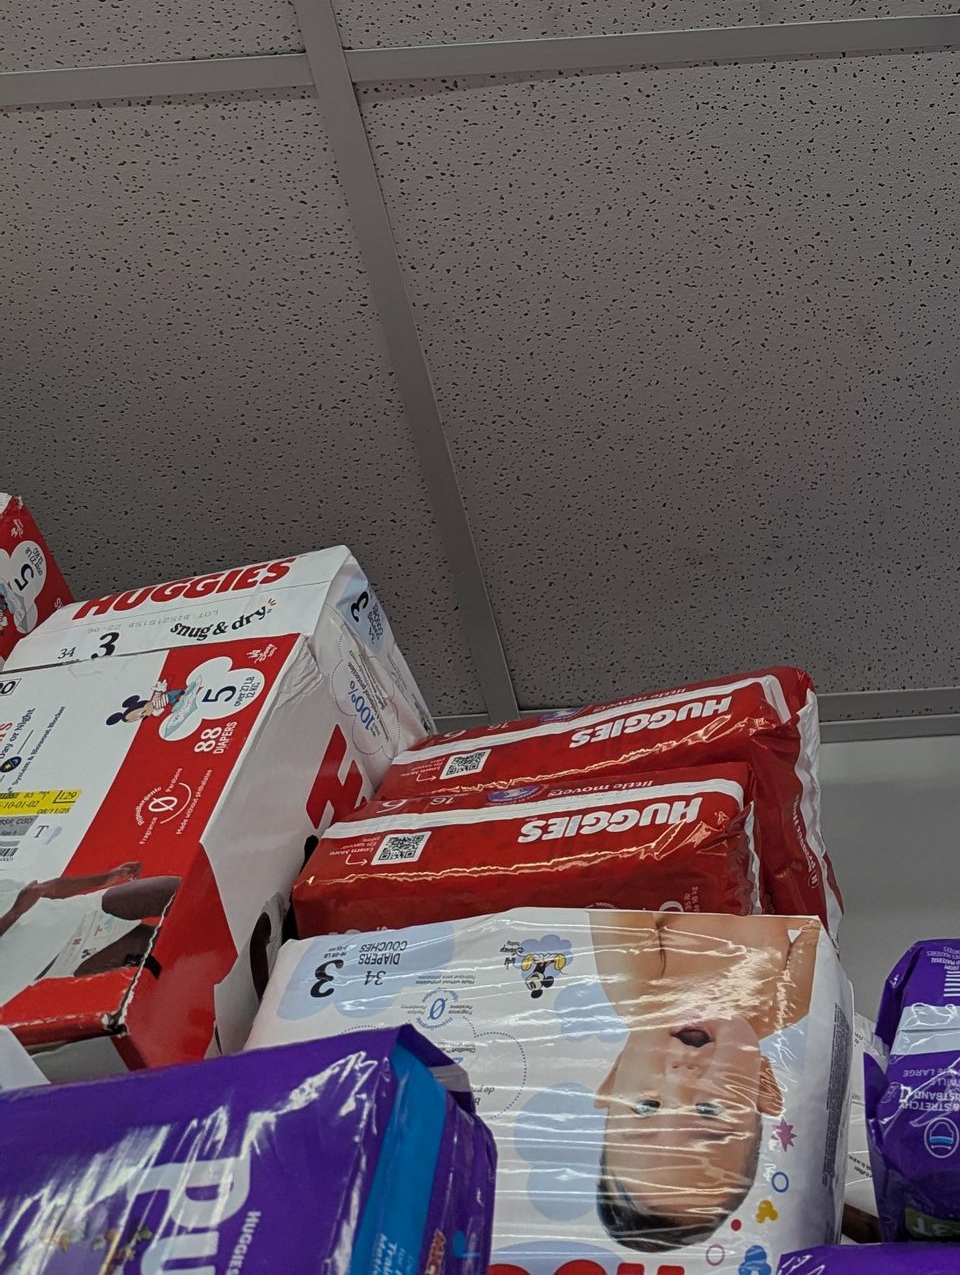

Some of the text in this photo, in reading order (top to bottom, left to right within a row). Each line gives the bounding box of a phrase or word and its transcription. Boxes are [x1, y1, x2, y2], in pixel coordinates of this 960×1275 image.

[14, 563, 34, 591] 5
[72, 556, 298, 621] HUGGIES
[350, 591, 369, 623] 3
[58, 604, 269, 660] 34 3 snug & dry
[202, 685, 237, 703] 5
[347, 679, 376, 731] 100%
[569, 696, 732, 749] HUGGIES
[194, 726, 223, 753] 88
[213, 721, 238, 755] DIAPERS
[547, 779, 654, 798] little movers
[517, 797, 703, 844] HUGGIES
[358, 952, 401, 965] DIAPERS
[359, 940, 409, 953] COUCHES
[310, 959, 344, 998] 3
[364, 969, 386, 986] 34
[902, 1067, 933, 1079] LARGE
